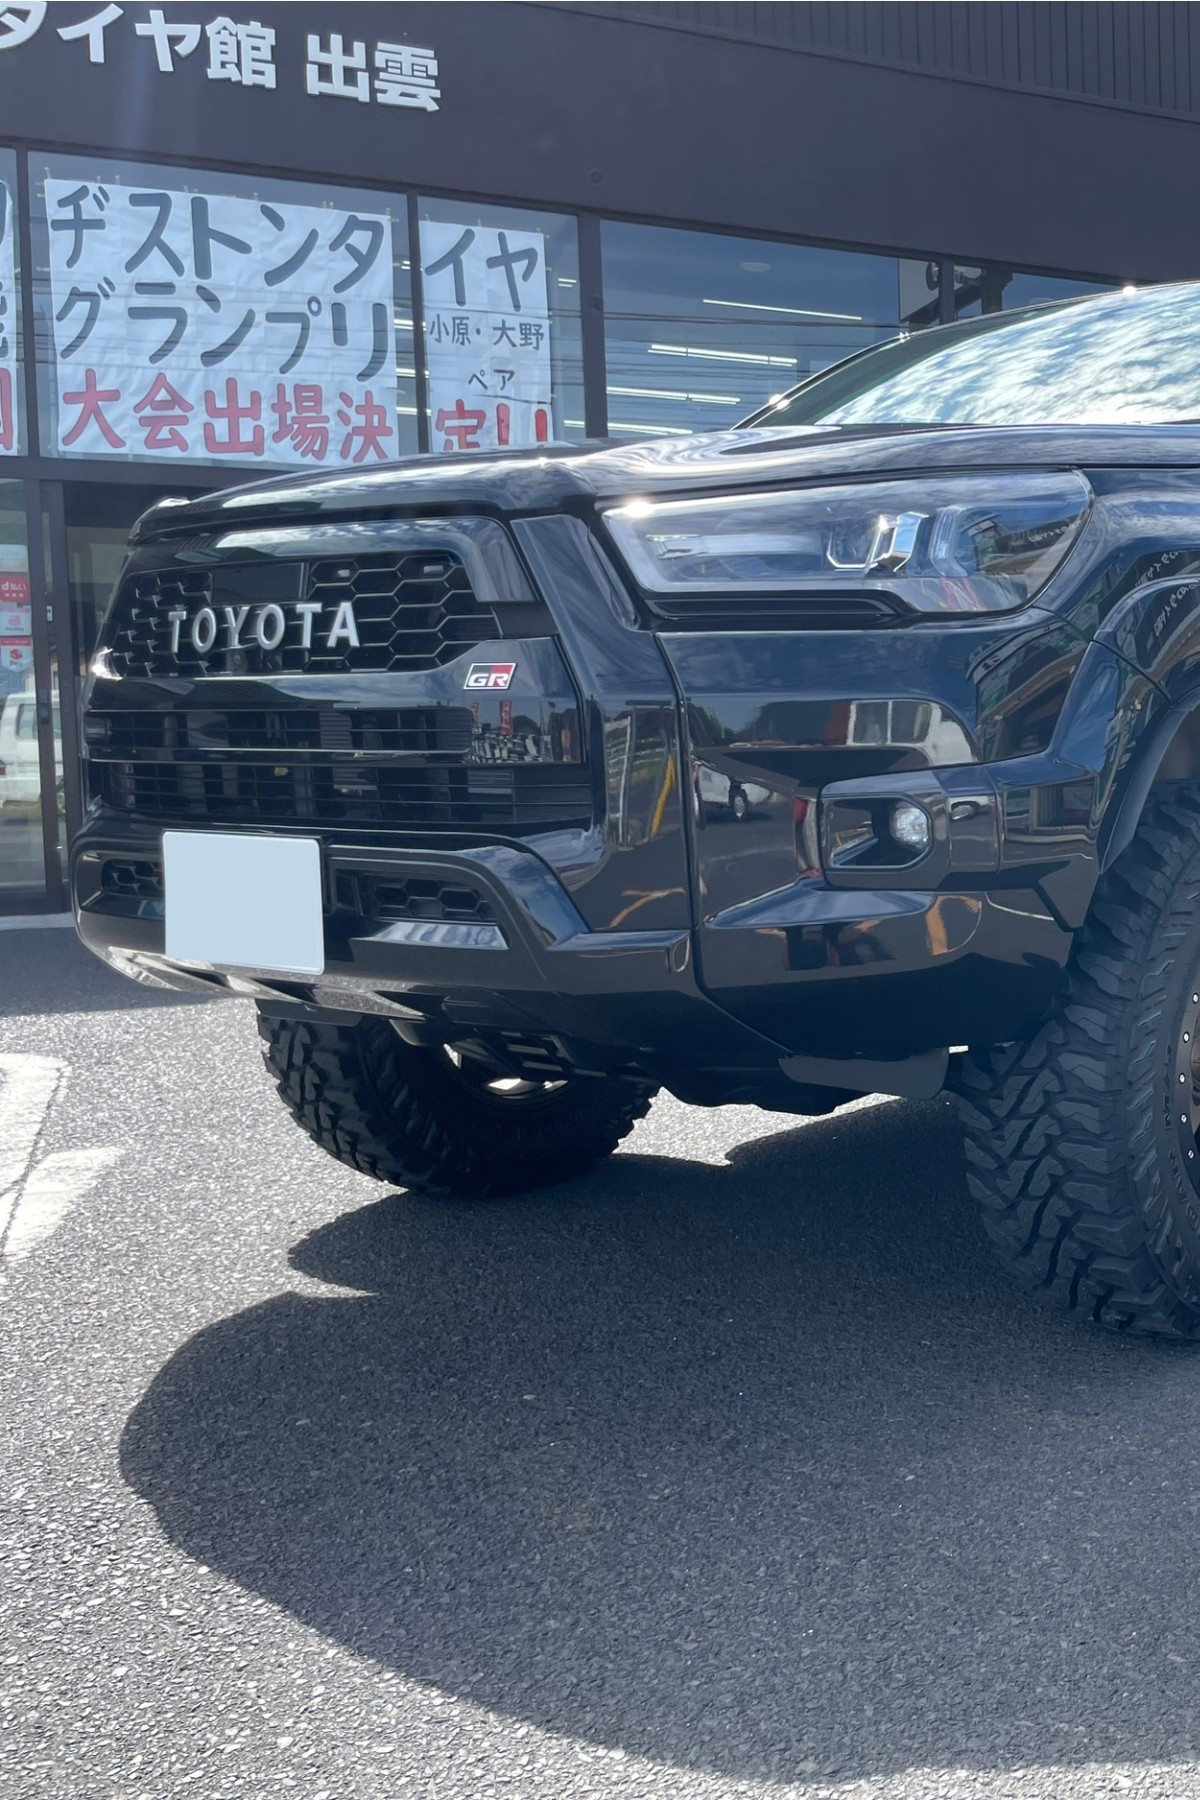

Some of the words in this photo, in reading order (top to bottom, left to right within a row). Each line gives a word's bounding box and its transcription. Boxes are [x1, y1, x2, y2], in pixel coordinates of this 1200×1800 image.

[0, 0, 277, 89] タイヤ館
[305, 33, 442, 112] 出雲
[55, 277, 391, 382] グランプリ
[168, 602, 360, 653] TOYOTA
[467, 673, 510, 687] GR
